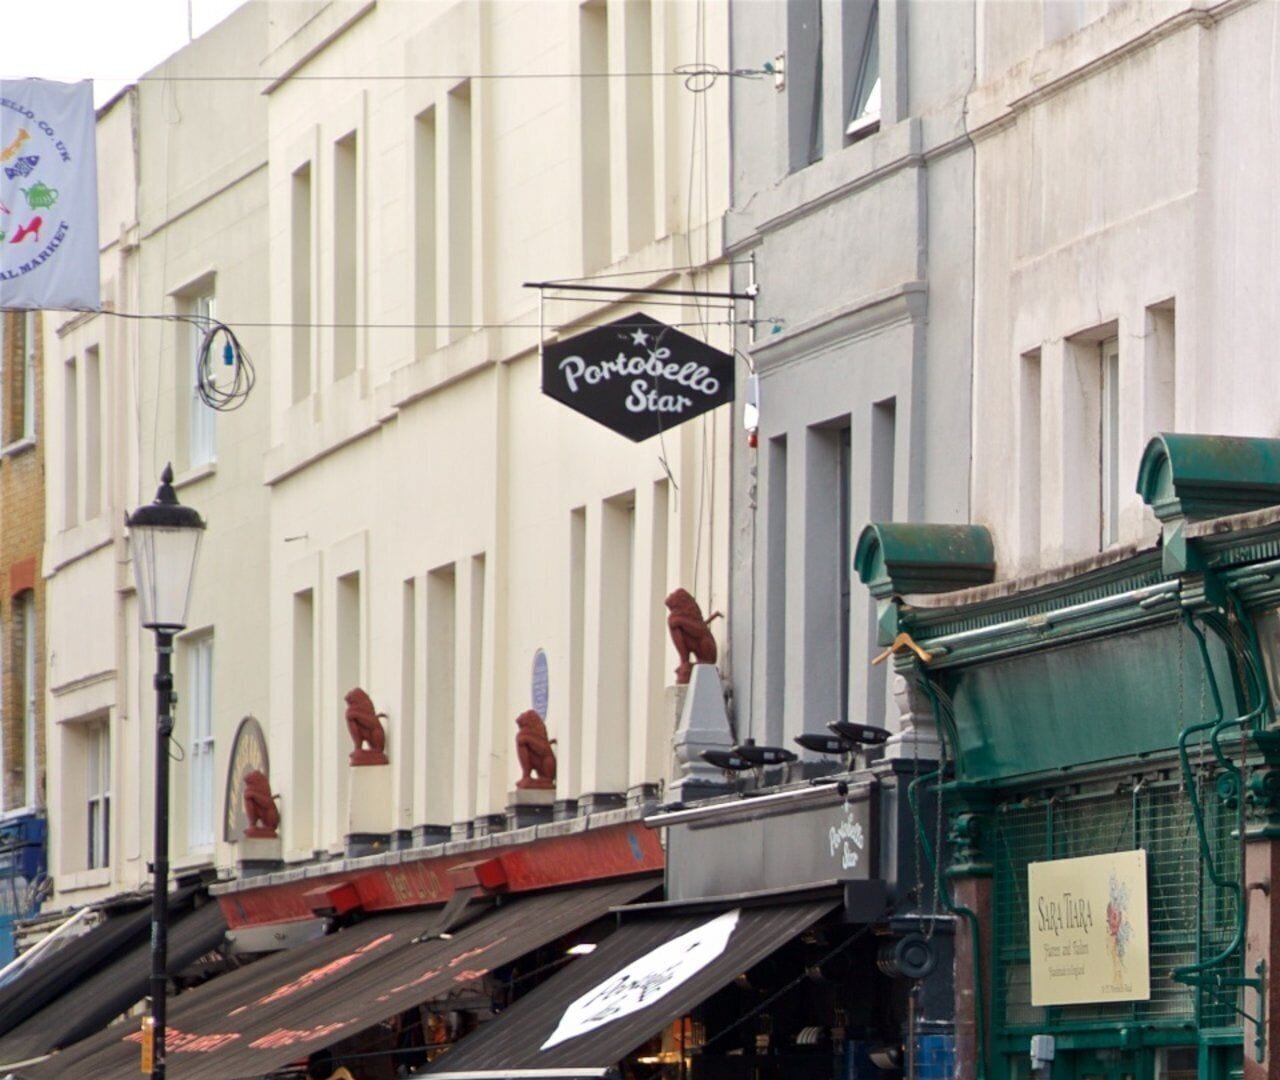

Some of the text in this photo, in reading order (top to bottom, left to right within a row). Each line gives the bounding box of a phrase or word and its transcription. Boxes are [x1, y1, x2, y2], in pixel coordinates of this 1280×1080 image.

[19, 220, 70, 275] MARKET
[558, 347, 720, 394] Portobello
[625, 379, 693, 413] Star
[1038, 892, 1093, 936] SARA TIARA
